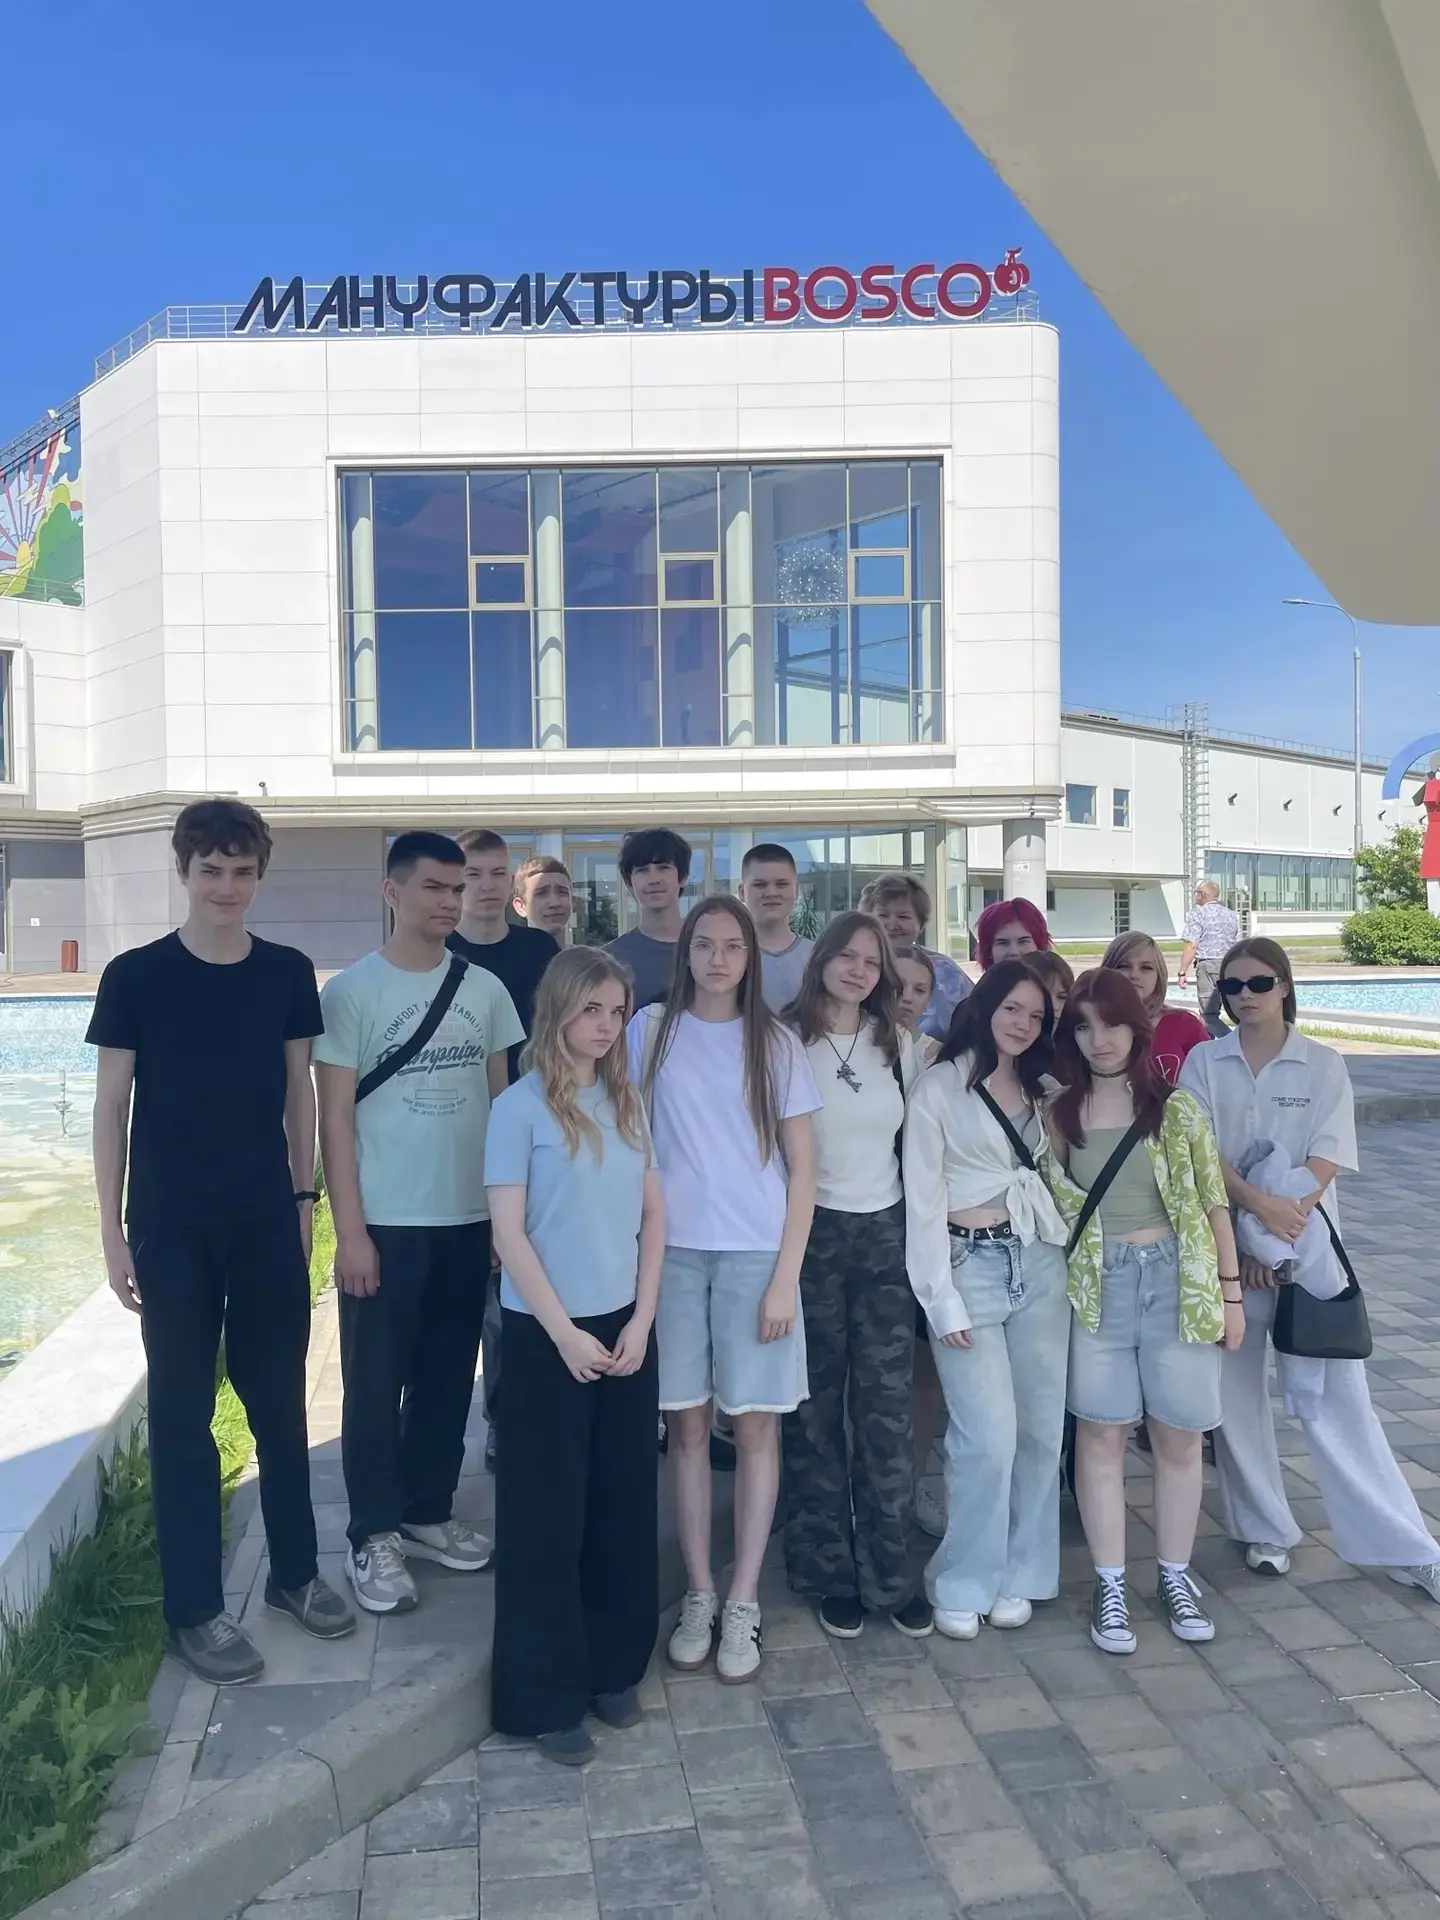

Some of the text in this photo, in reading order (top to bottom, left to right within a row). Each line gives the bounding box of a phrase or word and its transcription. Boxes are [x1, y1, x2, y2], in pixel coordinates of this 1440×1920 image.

[233, 268, 754, 334] МАНУФАКТУРЫ
[763, 263, 992, 323] BOSCO
[384, 1003, 421, 1042] COMFORT
[376, 1039, 485, 1075] Cmpaign
